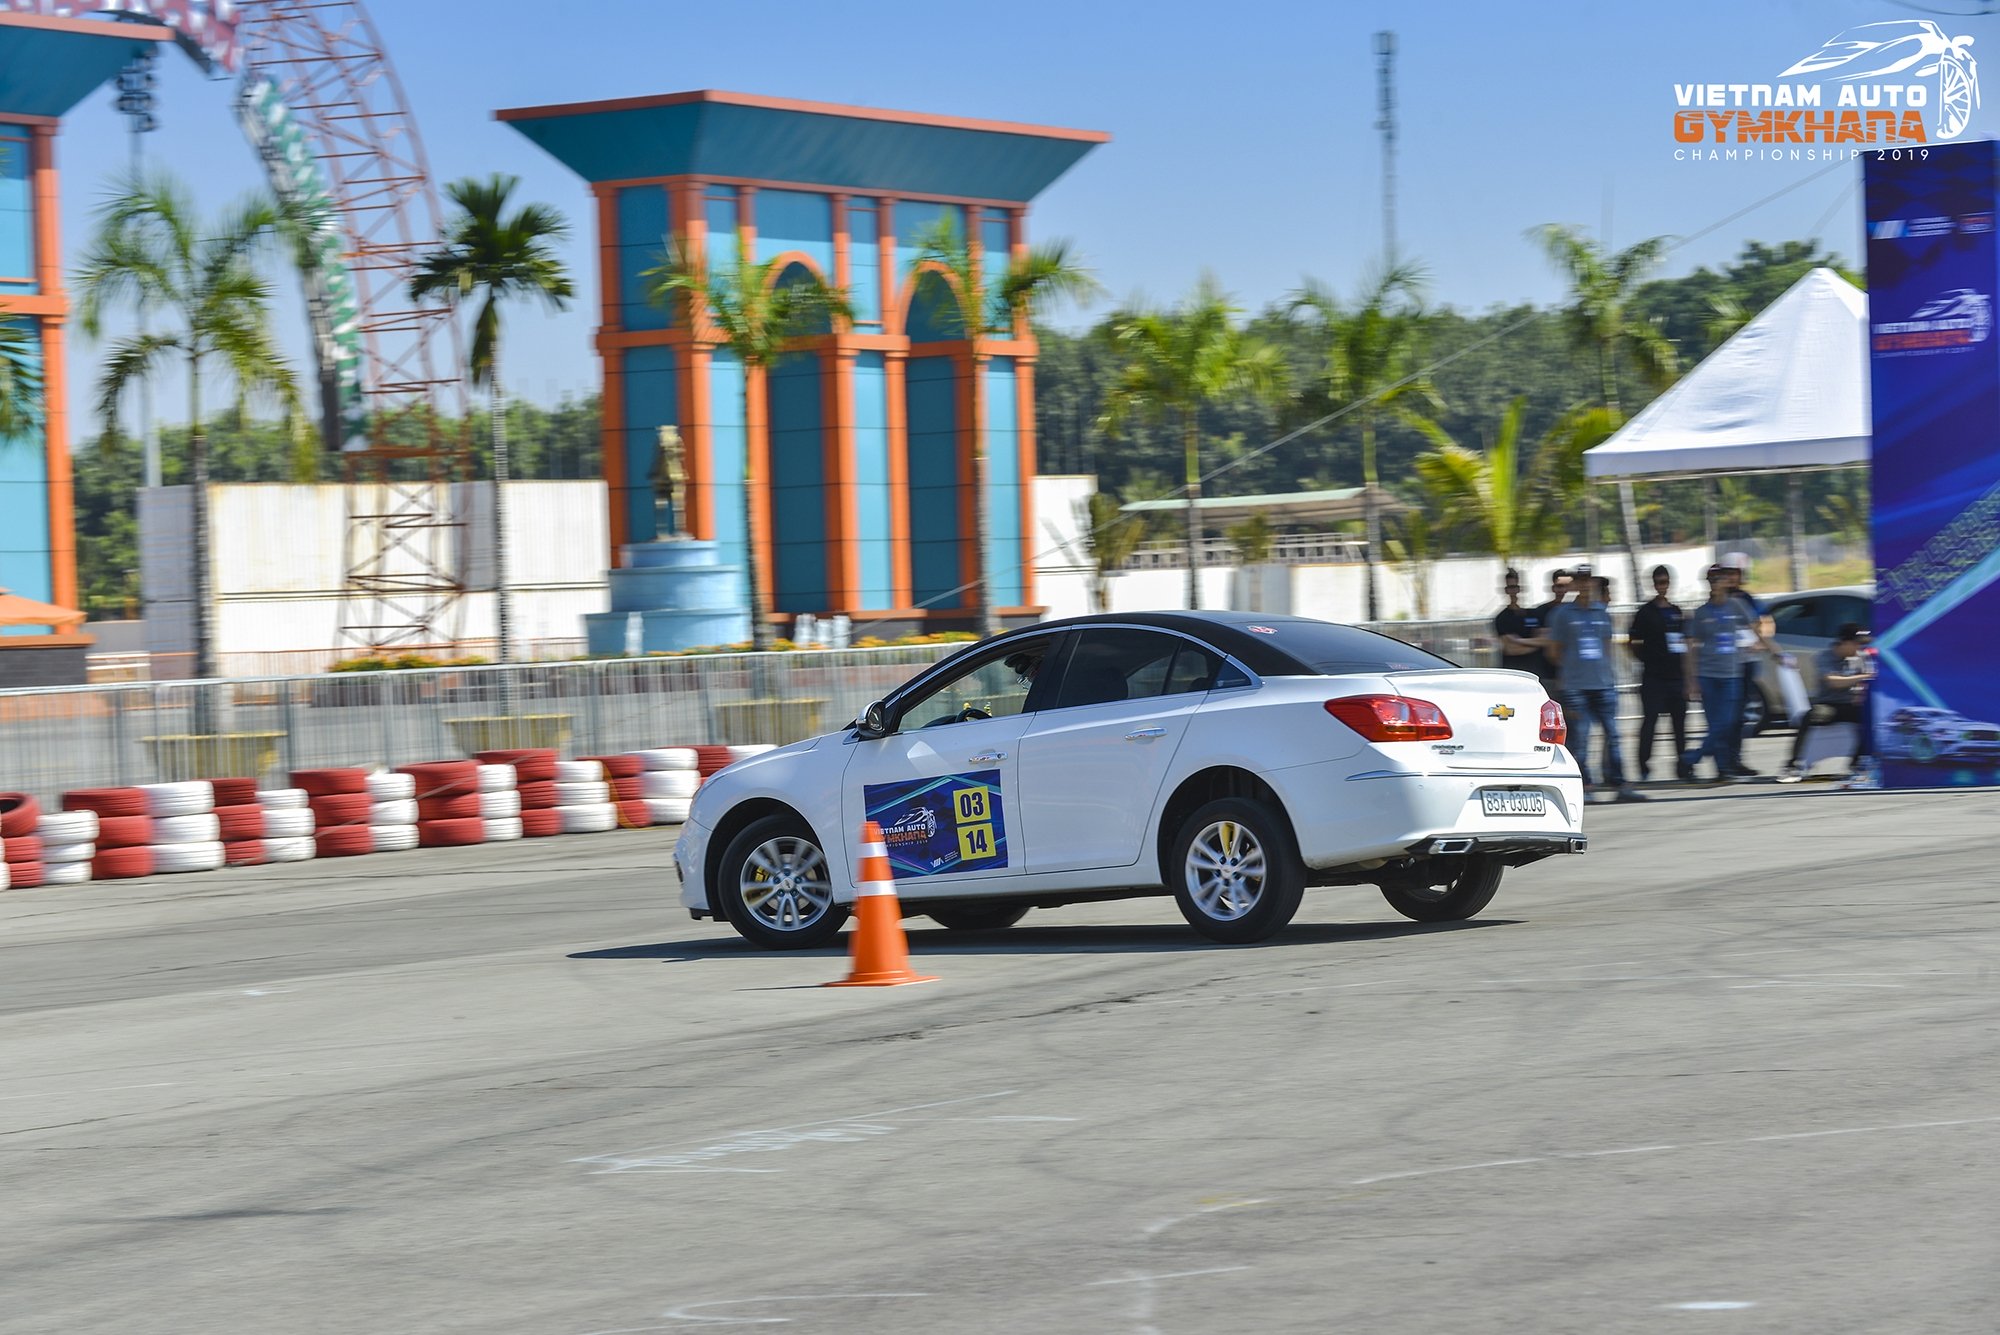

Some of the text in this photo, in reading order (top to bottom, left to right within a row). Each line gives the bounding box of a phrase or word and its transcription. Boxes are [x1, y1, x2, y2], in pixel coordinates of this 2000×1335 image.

[960, 791, 984, 819] 03
[907, 823, 926, 832] AUTO
[965, 829, 988, 855] 14
